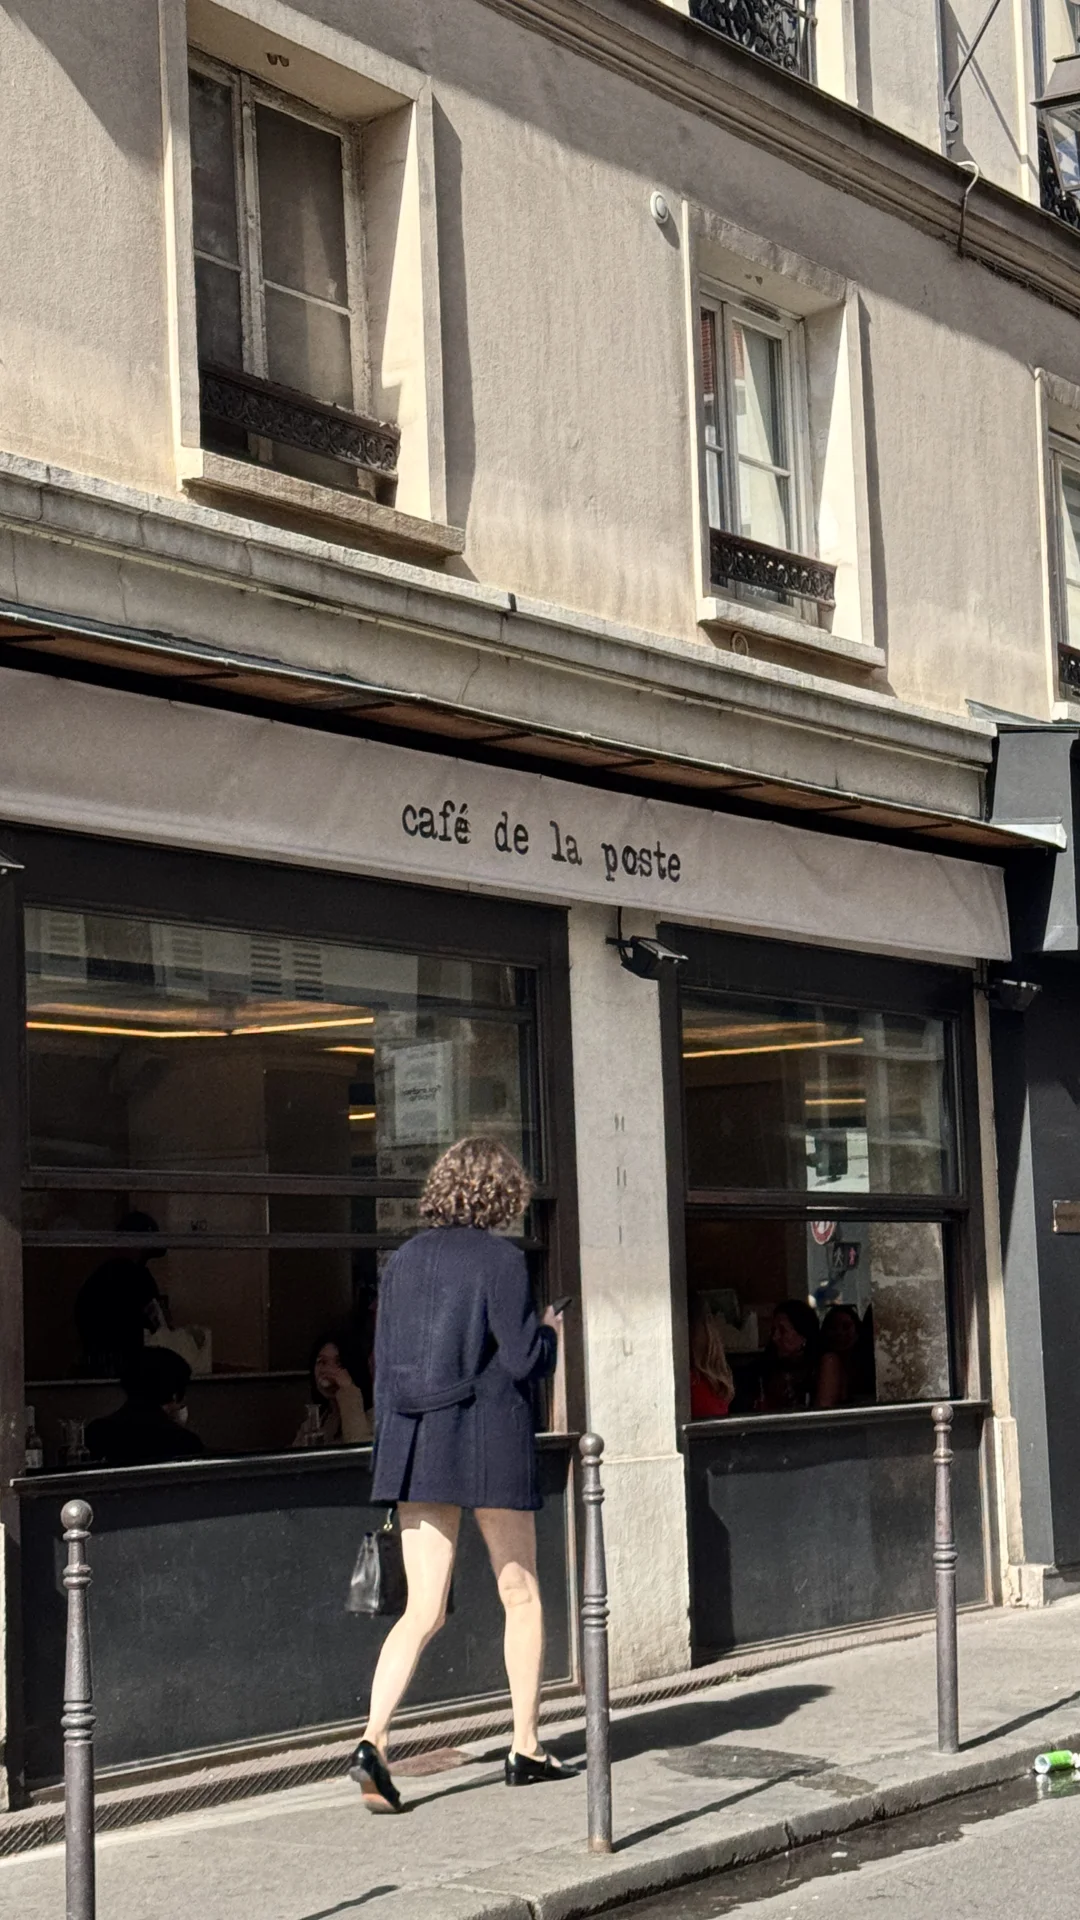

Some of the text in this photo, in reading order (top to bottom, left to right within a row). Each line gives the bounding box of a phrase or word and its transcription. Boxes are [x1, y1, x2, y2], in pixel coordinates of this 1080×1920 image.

[401, 799, 681, 884] café de la poste
